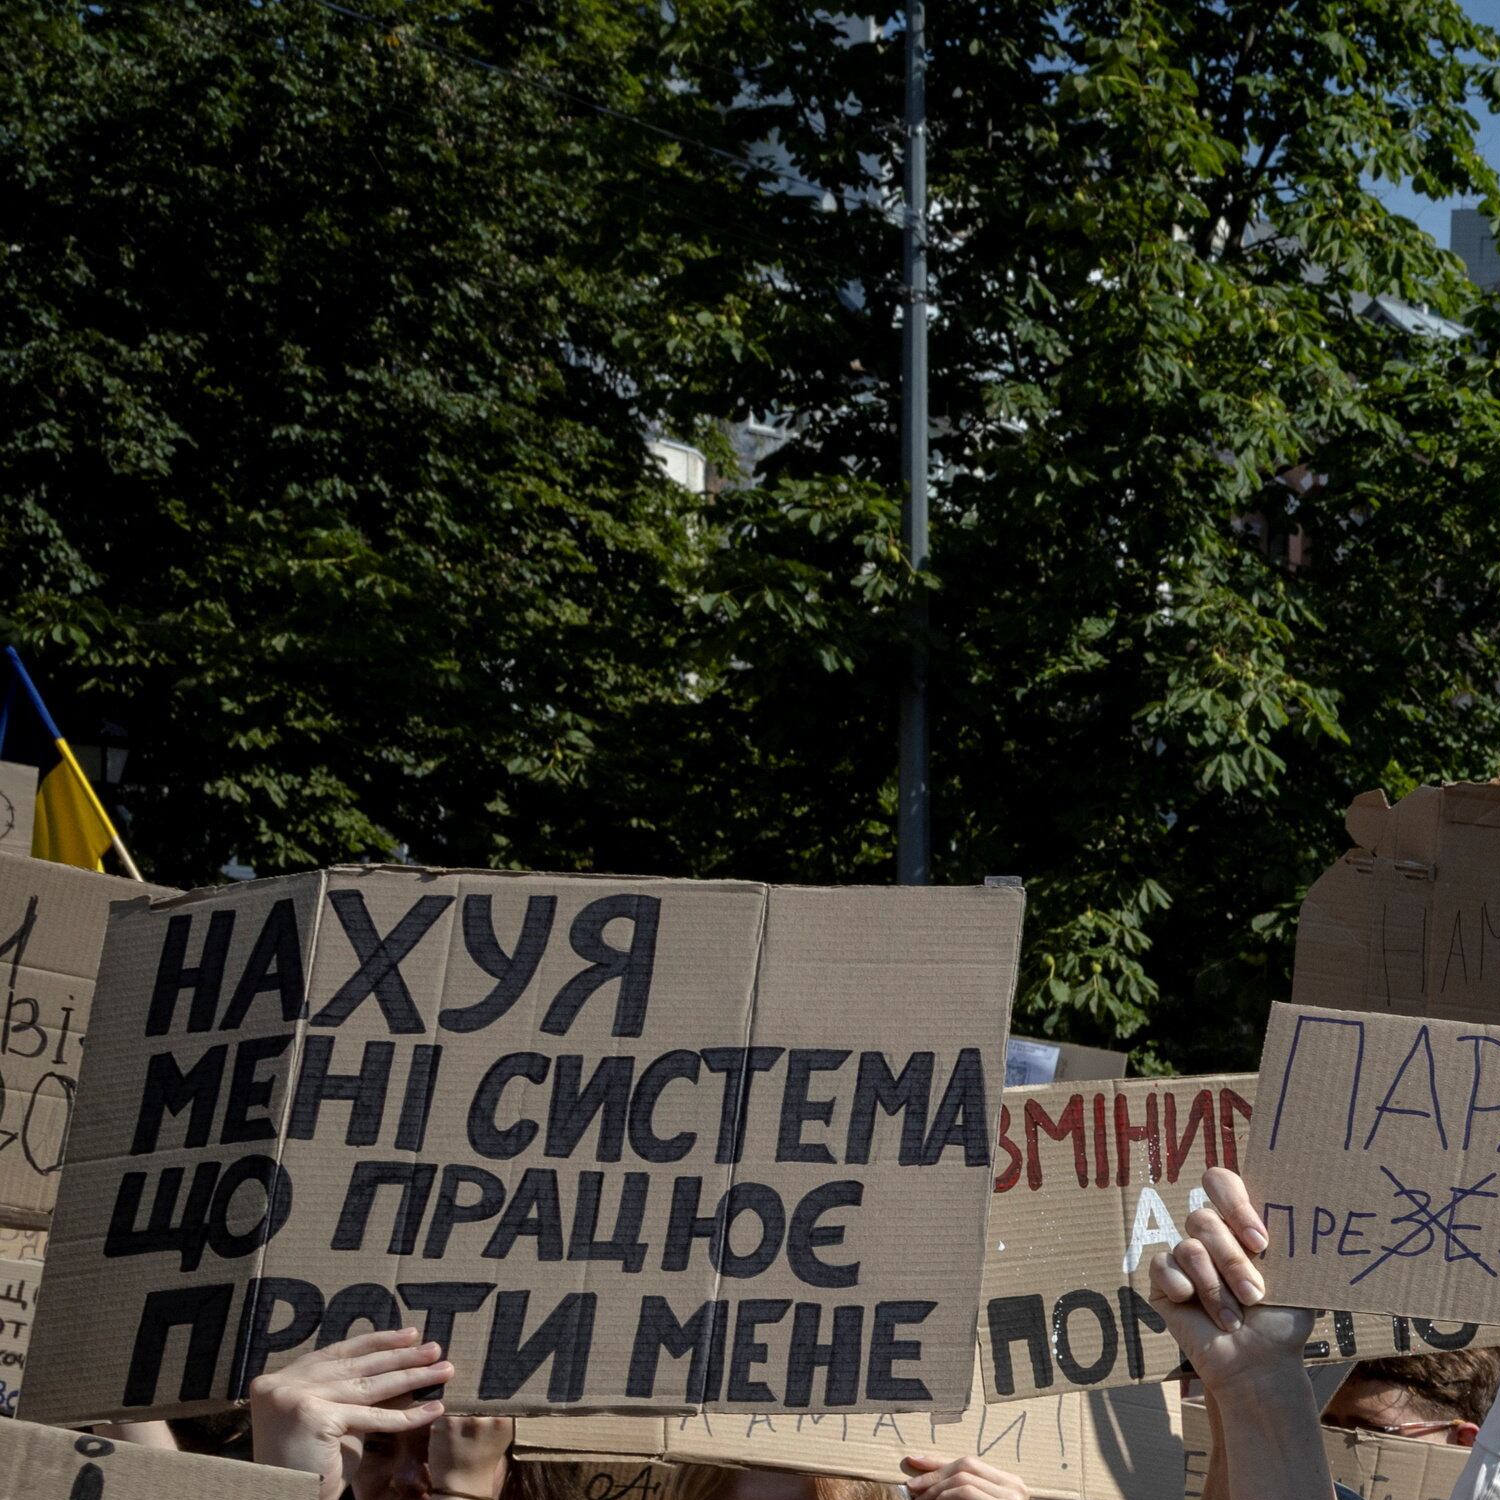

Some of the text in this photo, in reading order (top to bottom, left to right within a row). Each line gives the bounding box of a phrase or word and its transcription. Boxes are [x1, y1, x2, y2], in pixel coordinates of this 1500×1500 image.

[143, 887, 663, 1038] НАХУЯ
[129, 1033, 444, 1155] МЕНІ
[466, 1045, 993, 1167] СИСТЕМА
[103, 1153, 864, 1288] ЩО ПРАЦЮЄ
[625, 1293, 938, 1403] МЕНЕ
